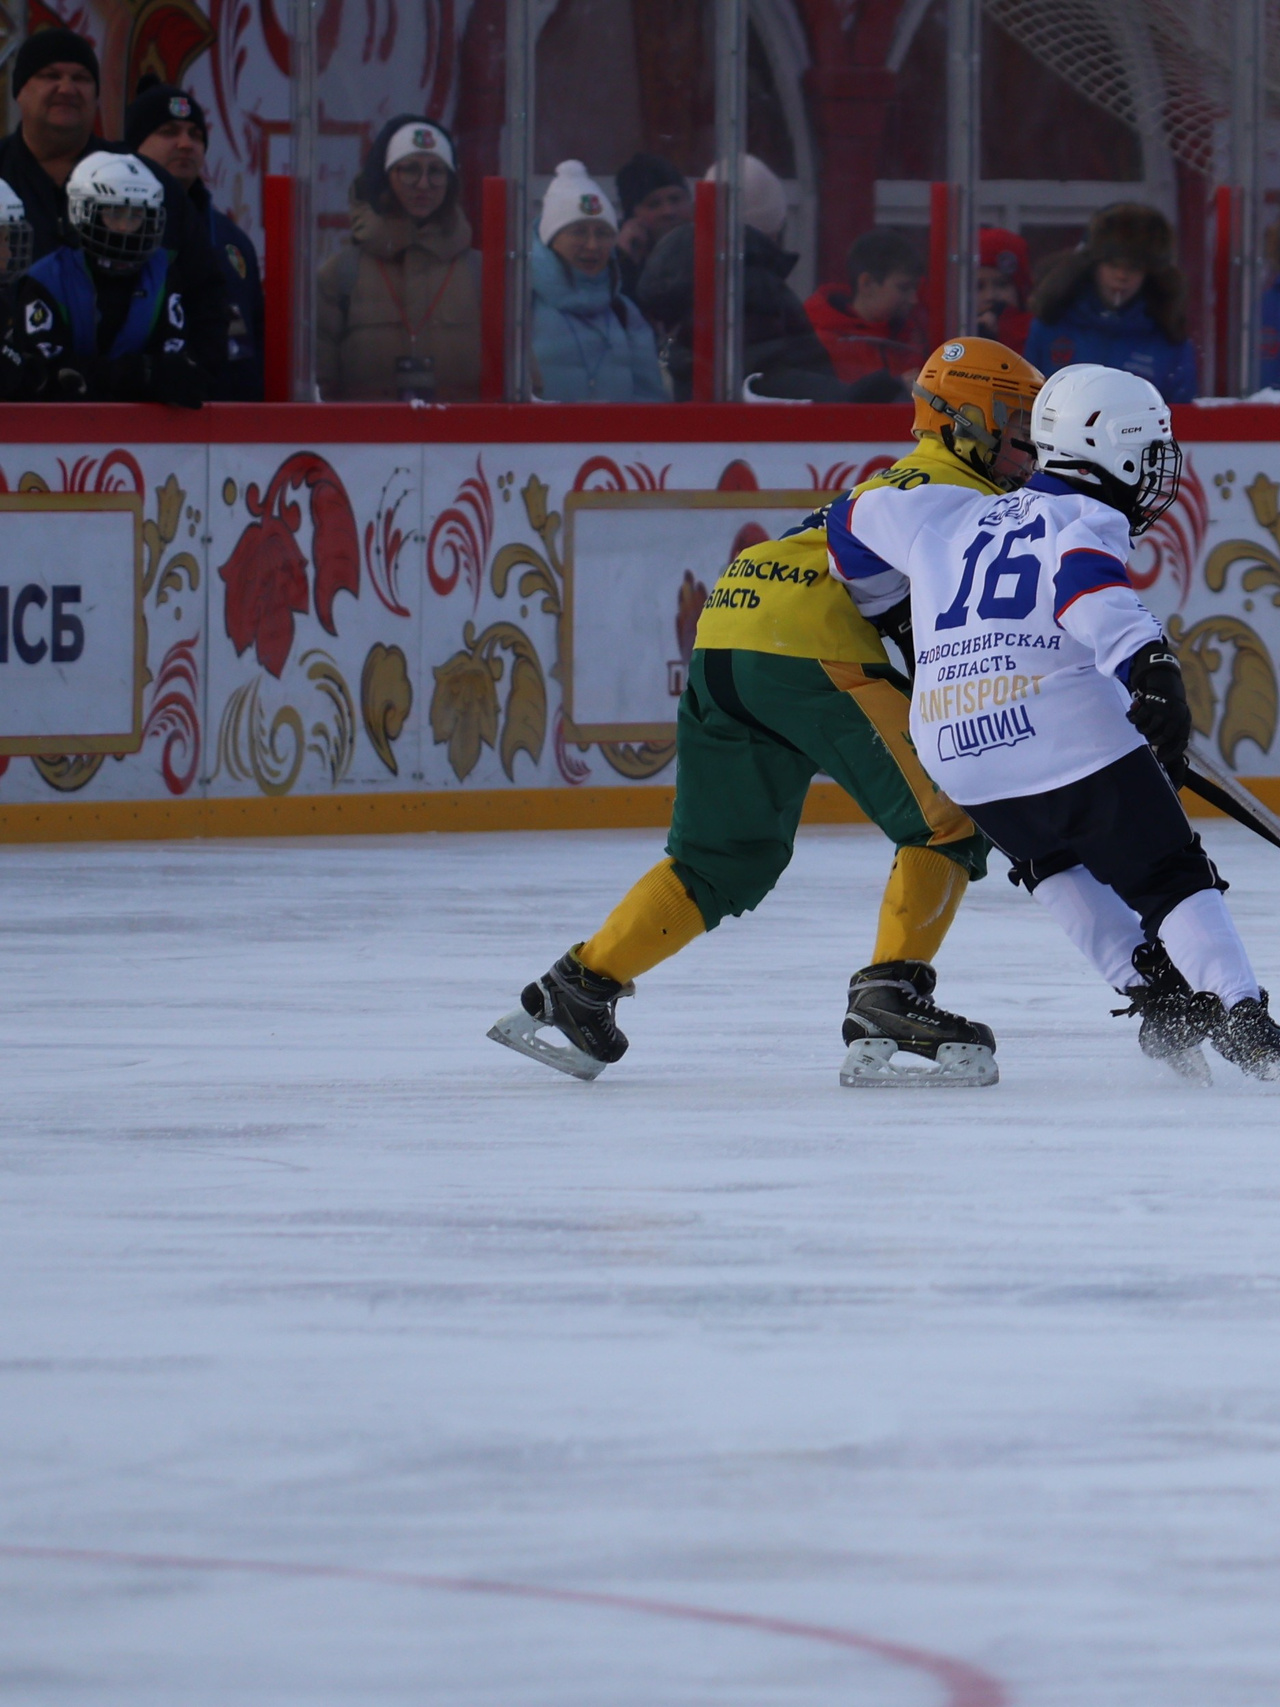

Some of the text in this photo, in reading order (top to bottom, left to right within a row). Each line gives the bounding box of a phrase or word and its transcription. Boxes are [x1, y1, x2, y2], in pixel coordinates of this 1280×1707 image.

[1121, 426, 1142, 434] CCM
[934, 513, 1046, 632] 16
[704, 588, 761, 609] БЛАСТЬ
[917, 632, 1061, 665] НОВОСИБИРСКАЯ
[937, 655, 1017, 682] ОБЛАСТЬ
[919, 674, 1047, 724] ANFISPORT
[955, 704, 1036, 751] ШПИЦ
[906, 1012, 941, 1026] CCM
